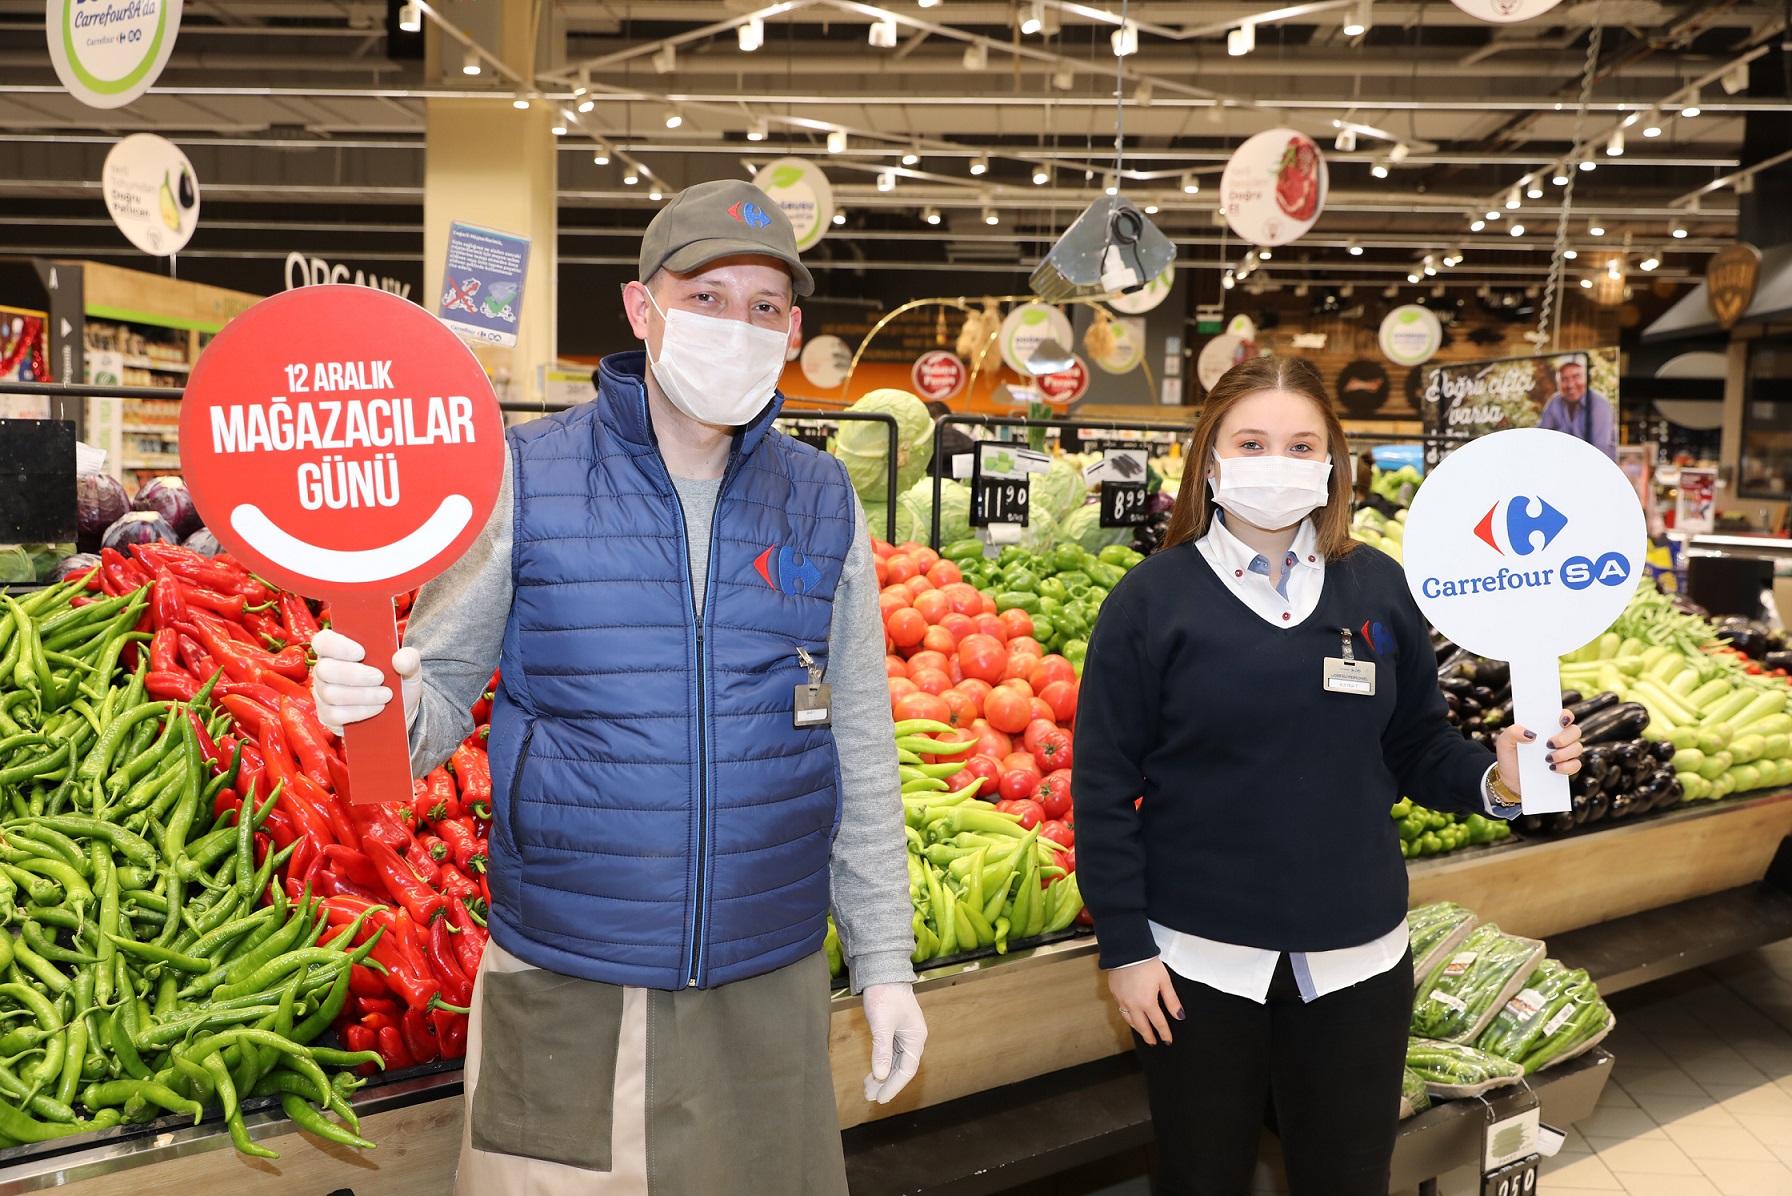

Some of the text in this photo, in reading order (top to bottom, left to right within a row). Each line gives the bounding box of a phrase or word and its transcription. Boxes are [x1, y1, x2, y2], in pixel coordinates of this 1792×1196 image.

[284, 360, 394, 393] 12 ARALIK
[210, 396, 476, 454] MAĞAZACILAR
[1448, 404, 1506, 426] varsa
[297, 452, 400, 510] GÜNÜ
[1422, 557, 1629, 599] Carrefour SA
